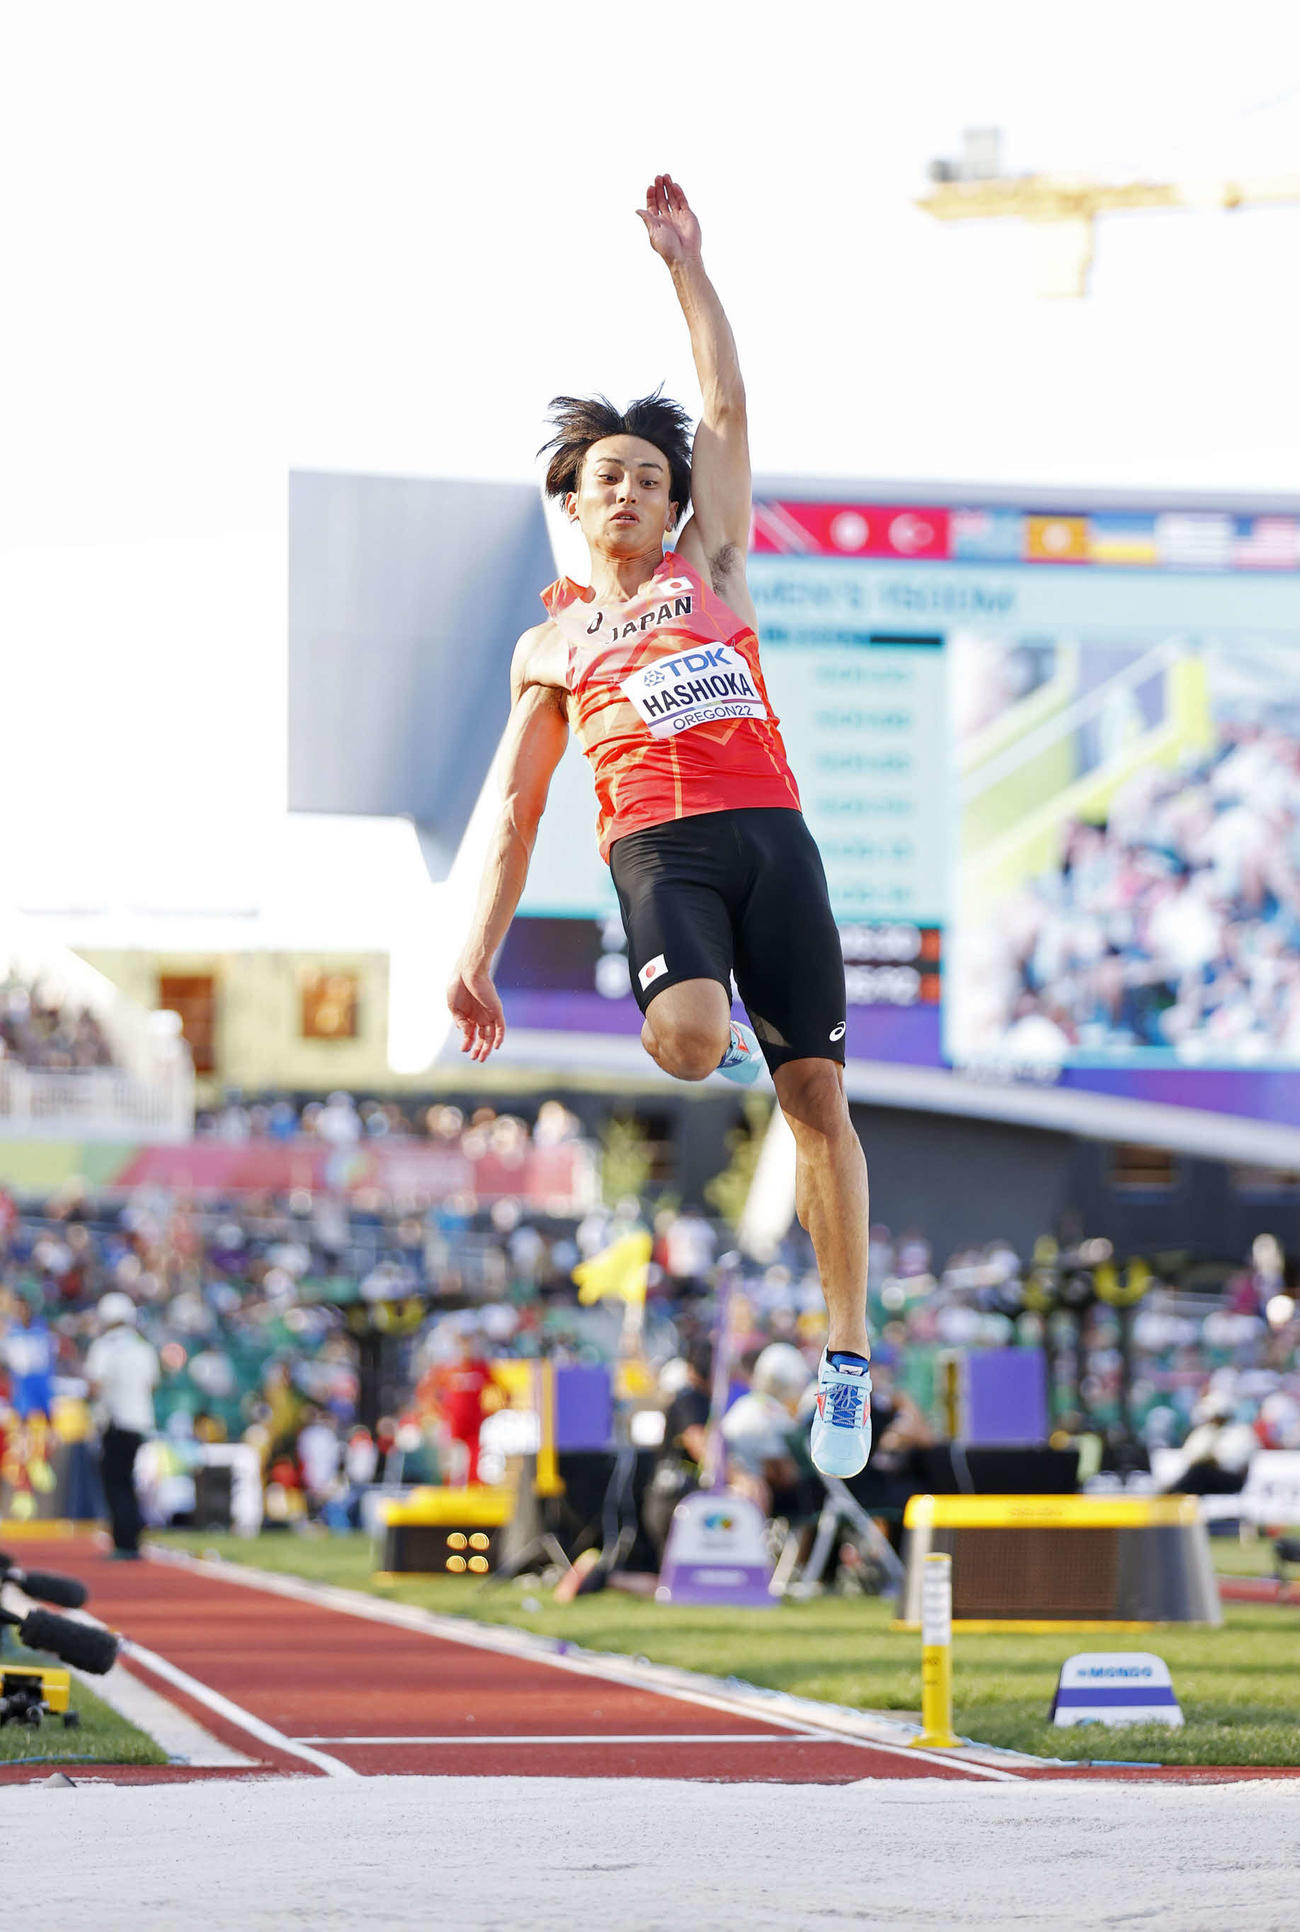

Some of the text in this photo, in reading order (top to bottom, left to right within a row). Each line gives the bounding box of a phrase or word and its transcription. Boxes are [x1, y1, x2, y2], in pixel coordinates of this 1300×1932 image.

[604, 595, 692, 645] JAPAN
[659, 647, 733, 678] TDK
[642, 672, 754, 718] HASHIOKA
[673, 704, 754, 731] OREGON22
